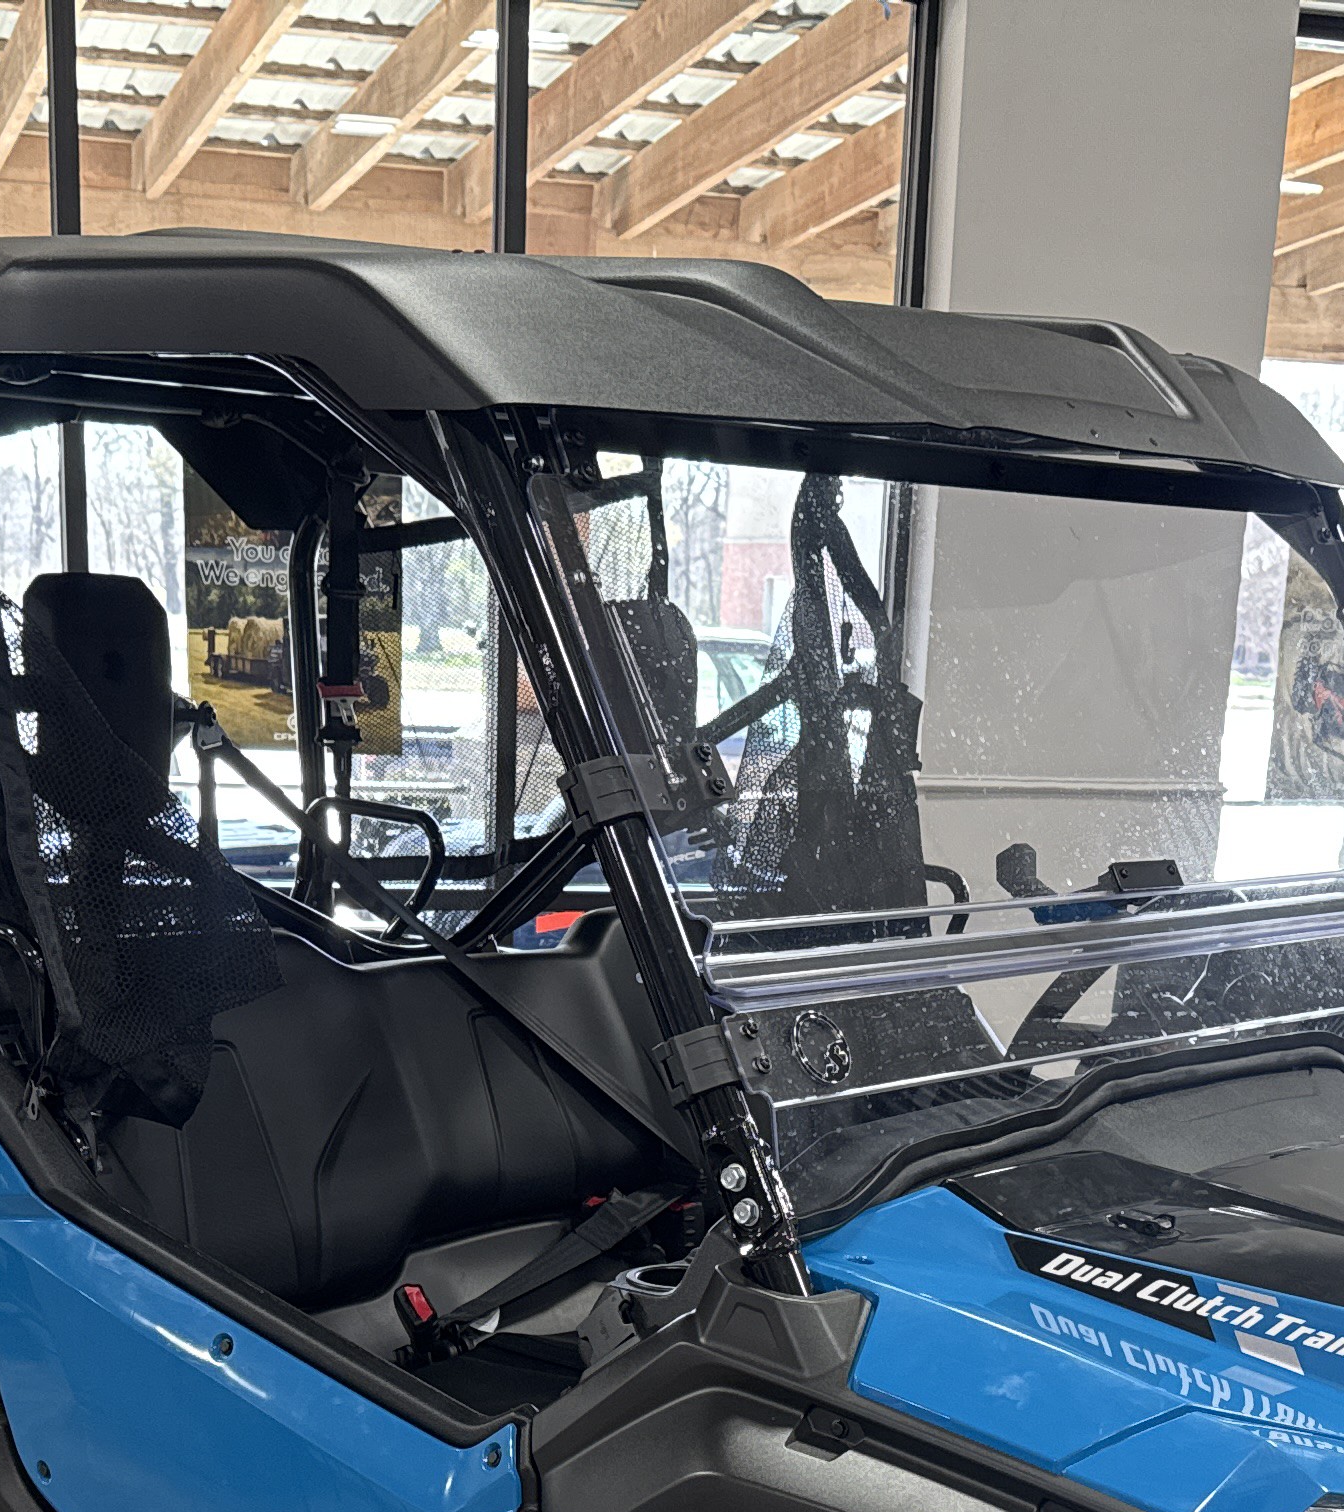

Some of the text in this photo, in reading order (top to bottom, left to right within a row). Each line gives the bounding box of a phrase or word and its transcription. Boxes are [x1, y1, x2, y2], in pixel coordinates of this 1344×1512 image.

[226, 536, 275, 563] You
[196, 559, 241, 587] We
[1039, 1252, 1143, 1293] Dual
[1136, 1278, 1265, 1329] Clutch
